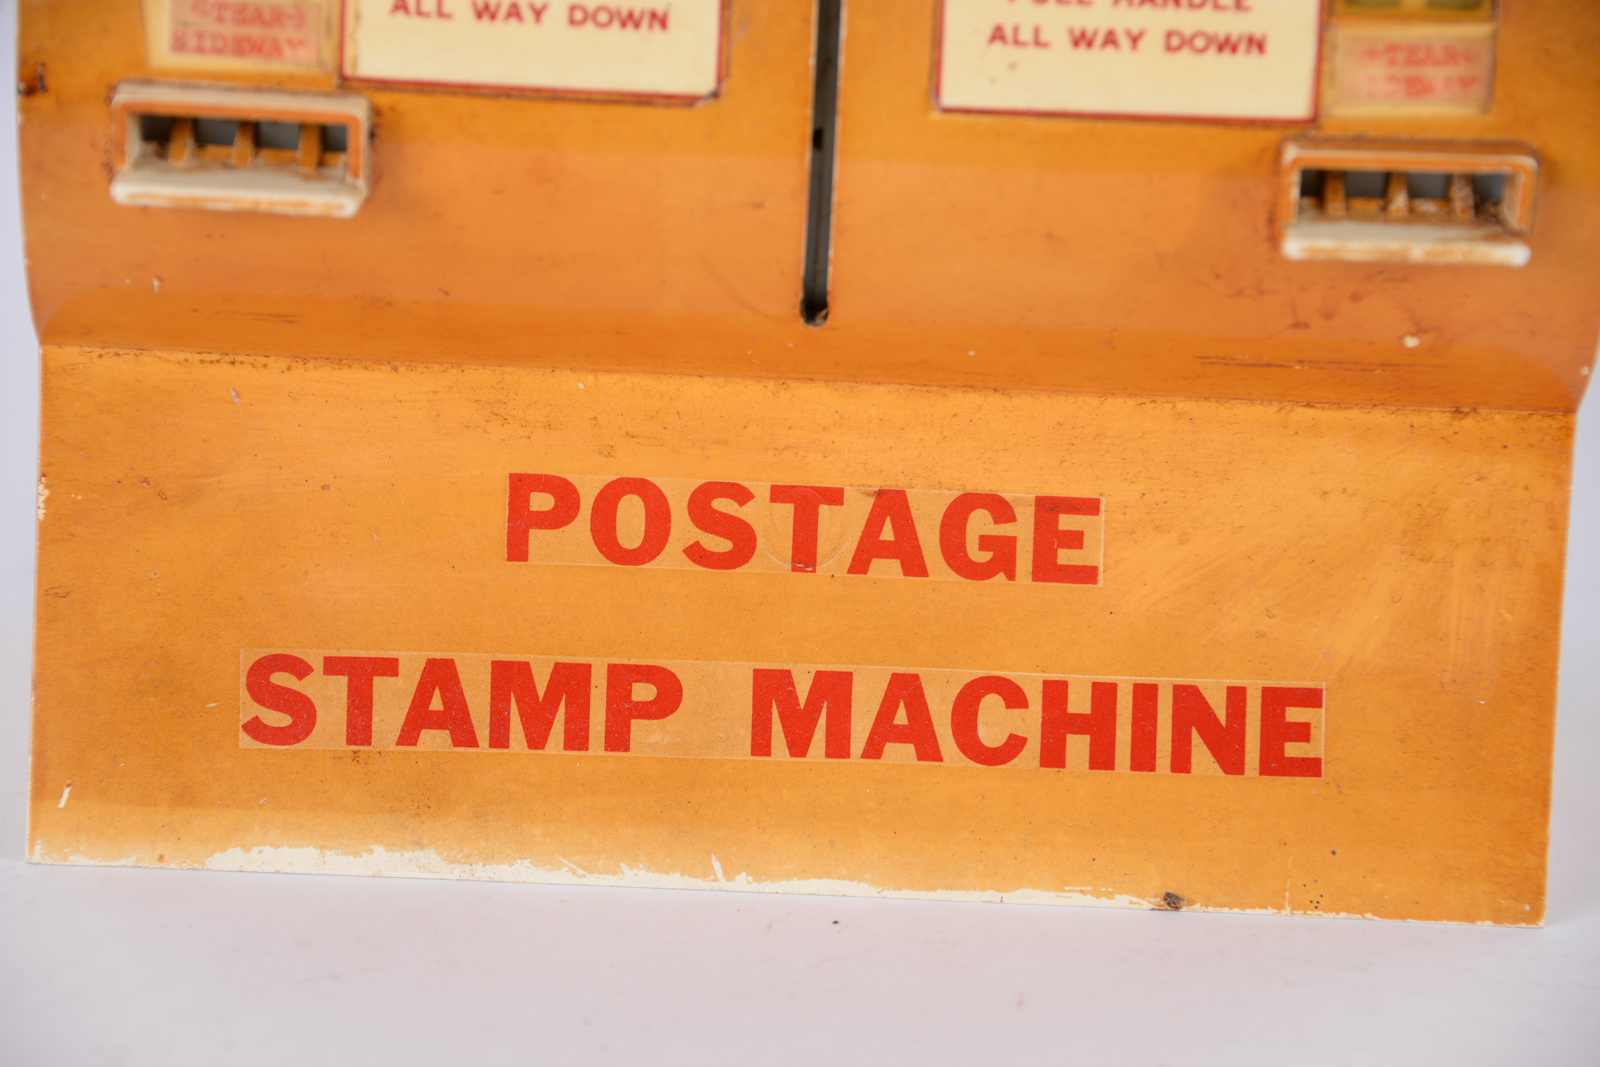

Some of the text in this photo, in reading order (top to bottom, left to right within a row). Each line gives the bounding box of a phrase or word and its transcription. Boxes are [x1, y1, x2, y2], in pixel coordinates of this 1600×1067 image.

[391, 0, 669, 31] ALL WAY DOWN
[988, 24, 1267, 55] ALL WAY DOWN
[507, 473, 1101, 585] POSTAGE
[241, 653, 1324, 777] STAMP MACHINE
